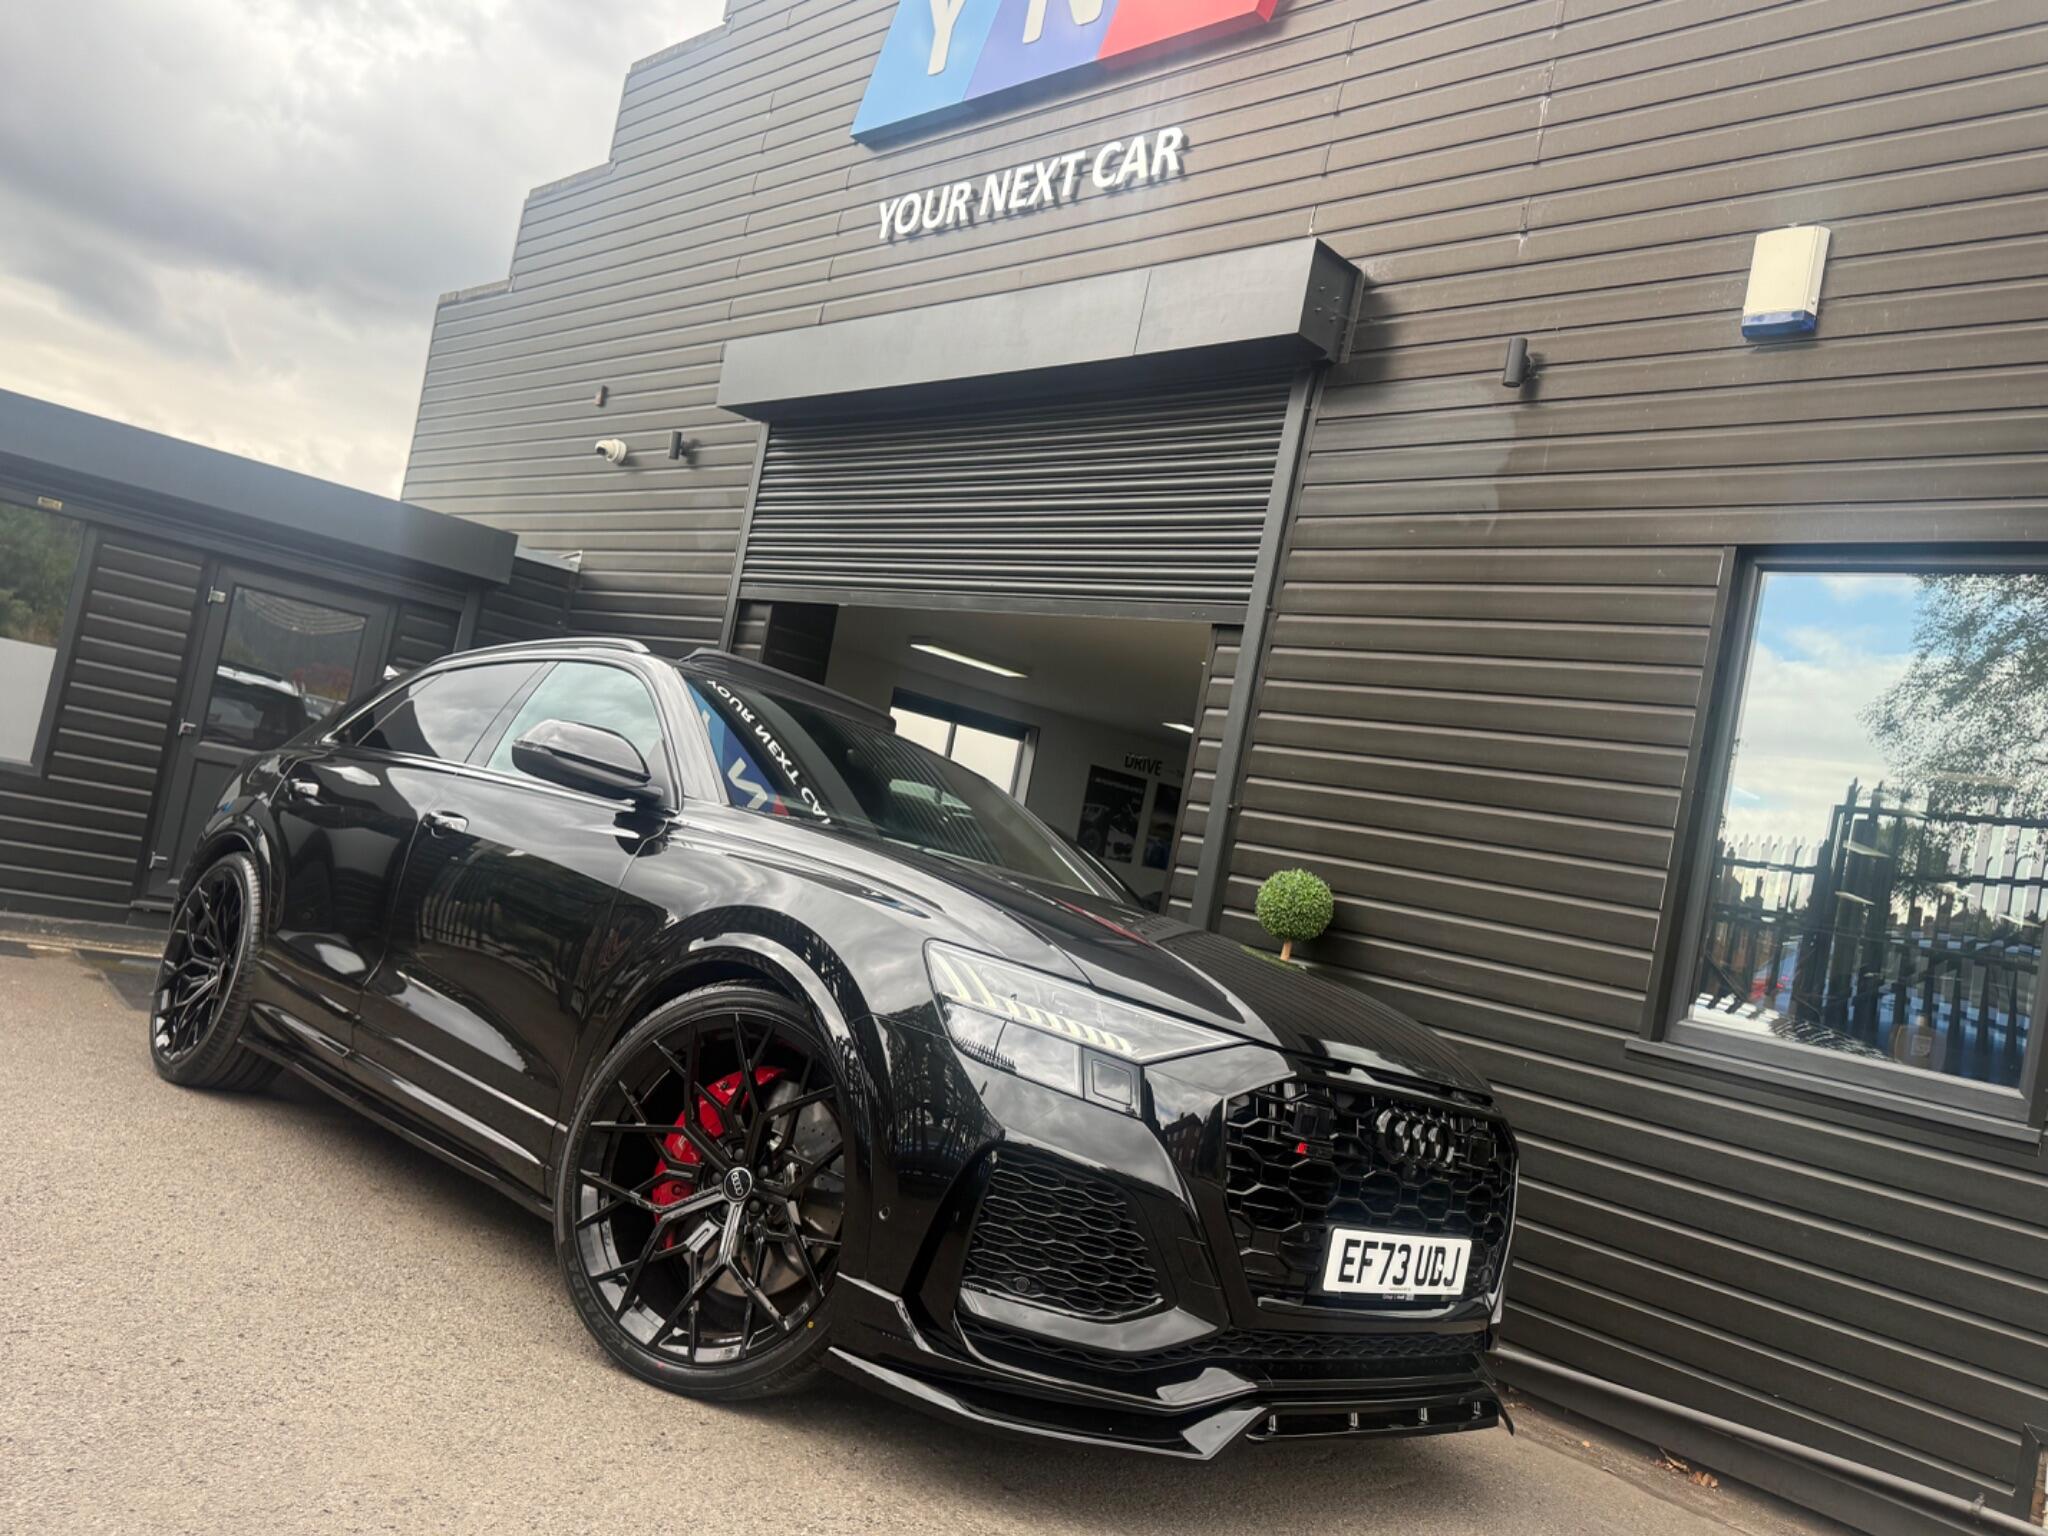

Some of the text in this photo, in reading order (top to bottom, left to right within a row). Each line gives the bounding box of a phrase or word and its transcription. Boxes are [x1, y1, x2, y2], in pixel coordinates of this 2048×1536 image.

[879, 127, 1183, 239] YOUR NEXT CAR
[1124, 754, 1163, 776] DRIVE
[1338, 1239, 1411, 1286] EF73
